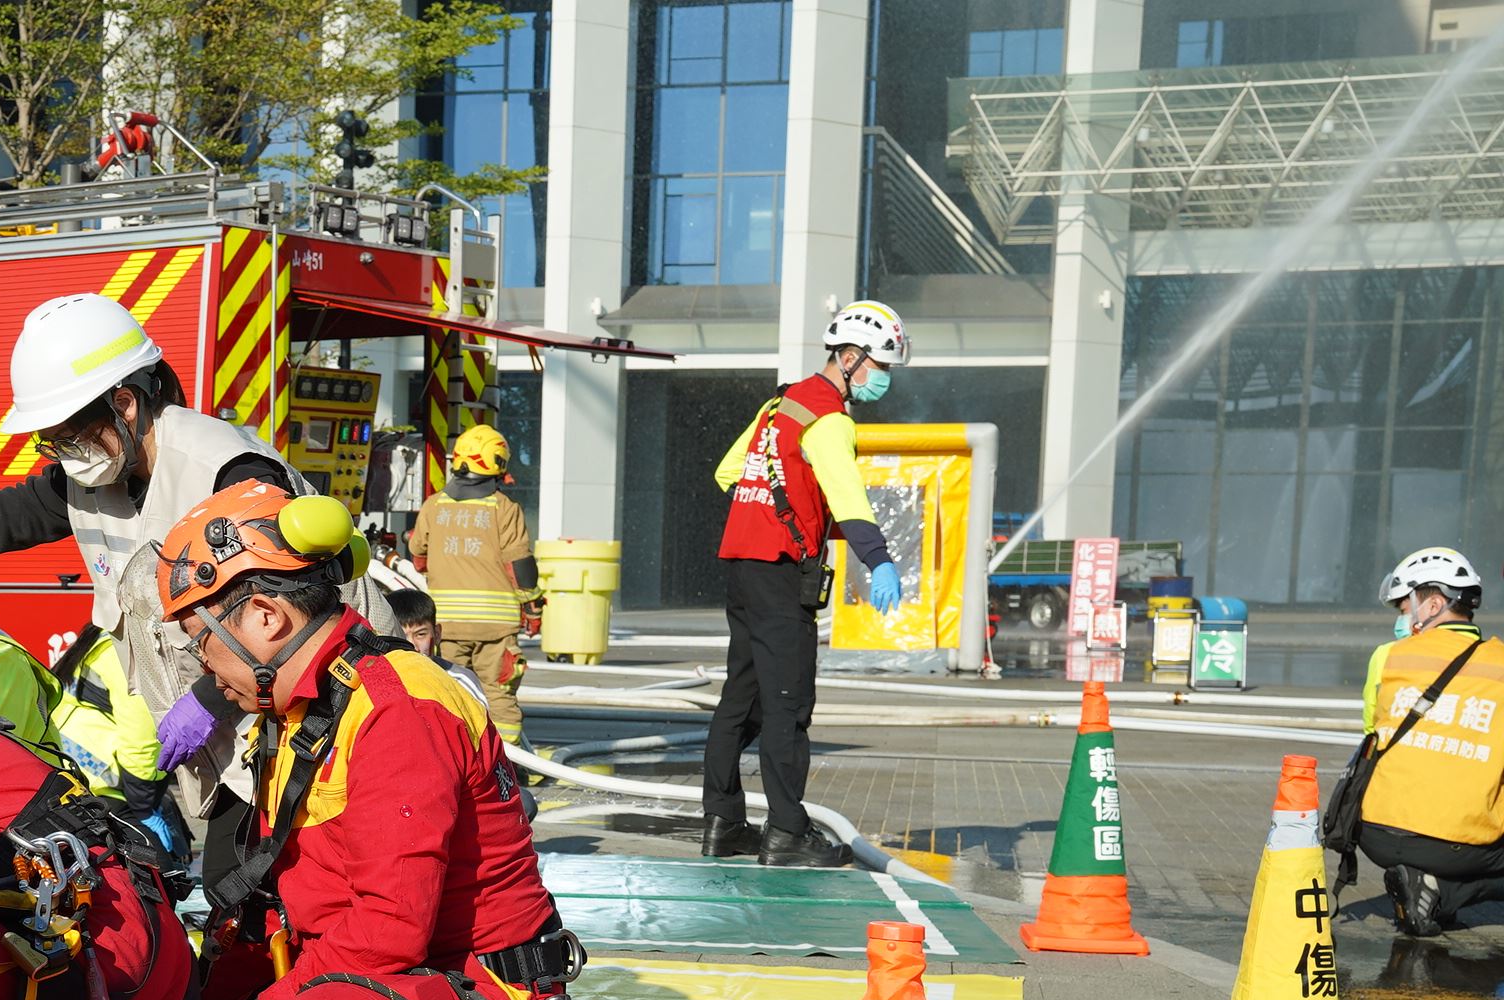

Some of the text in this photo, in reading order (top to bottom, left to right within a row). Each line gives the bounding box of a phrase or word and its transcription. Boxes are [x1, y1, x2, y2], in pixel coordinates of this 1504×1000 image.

[436, 507, 491, 529] 新竹縣
[443, 536, 483, 557] 消防
[1094, 613, 1120, 638] 熱
[1200, 638, 1238, 674] 冷
[1088, 746, 1123, 861] 輕傷區
